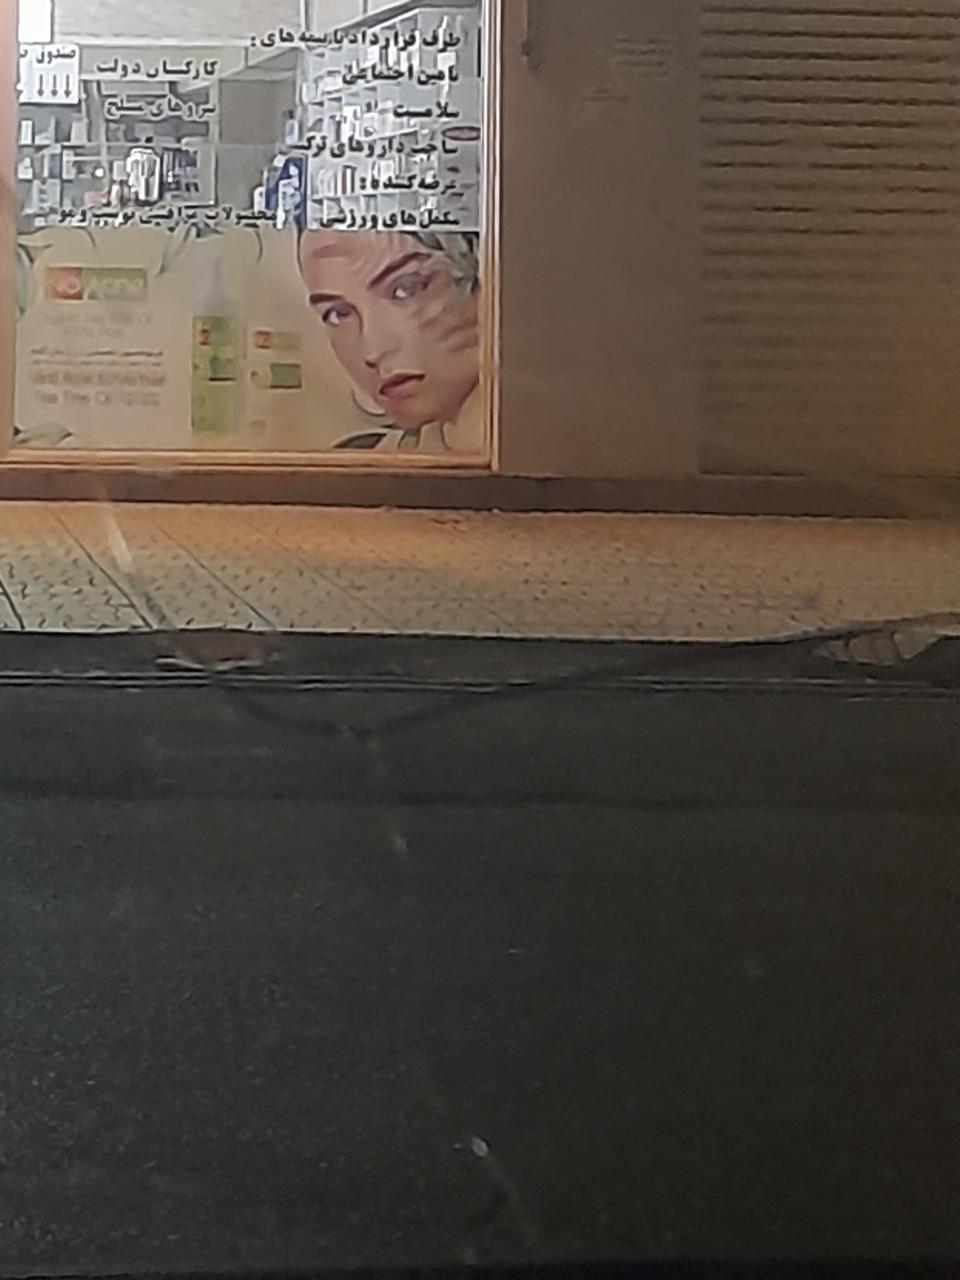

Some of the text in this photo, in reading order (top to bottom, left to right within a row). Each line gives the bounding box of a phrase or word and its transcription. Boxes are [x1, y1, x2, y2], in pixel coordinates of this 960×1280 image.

[349, 28, 417, 51] قرارداد
[422, 32, 461, 53] طرف
[96, 58, 218, 80] کارکنان دولت
[342, 63, 414, 86] اجتماعی
[393, 101, 460, 118] سلامت
[330, 135, 404, 158] داروهای
[319, 207, 378, 229] ورزشی
[382, 208, 417, 227] های
